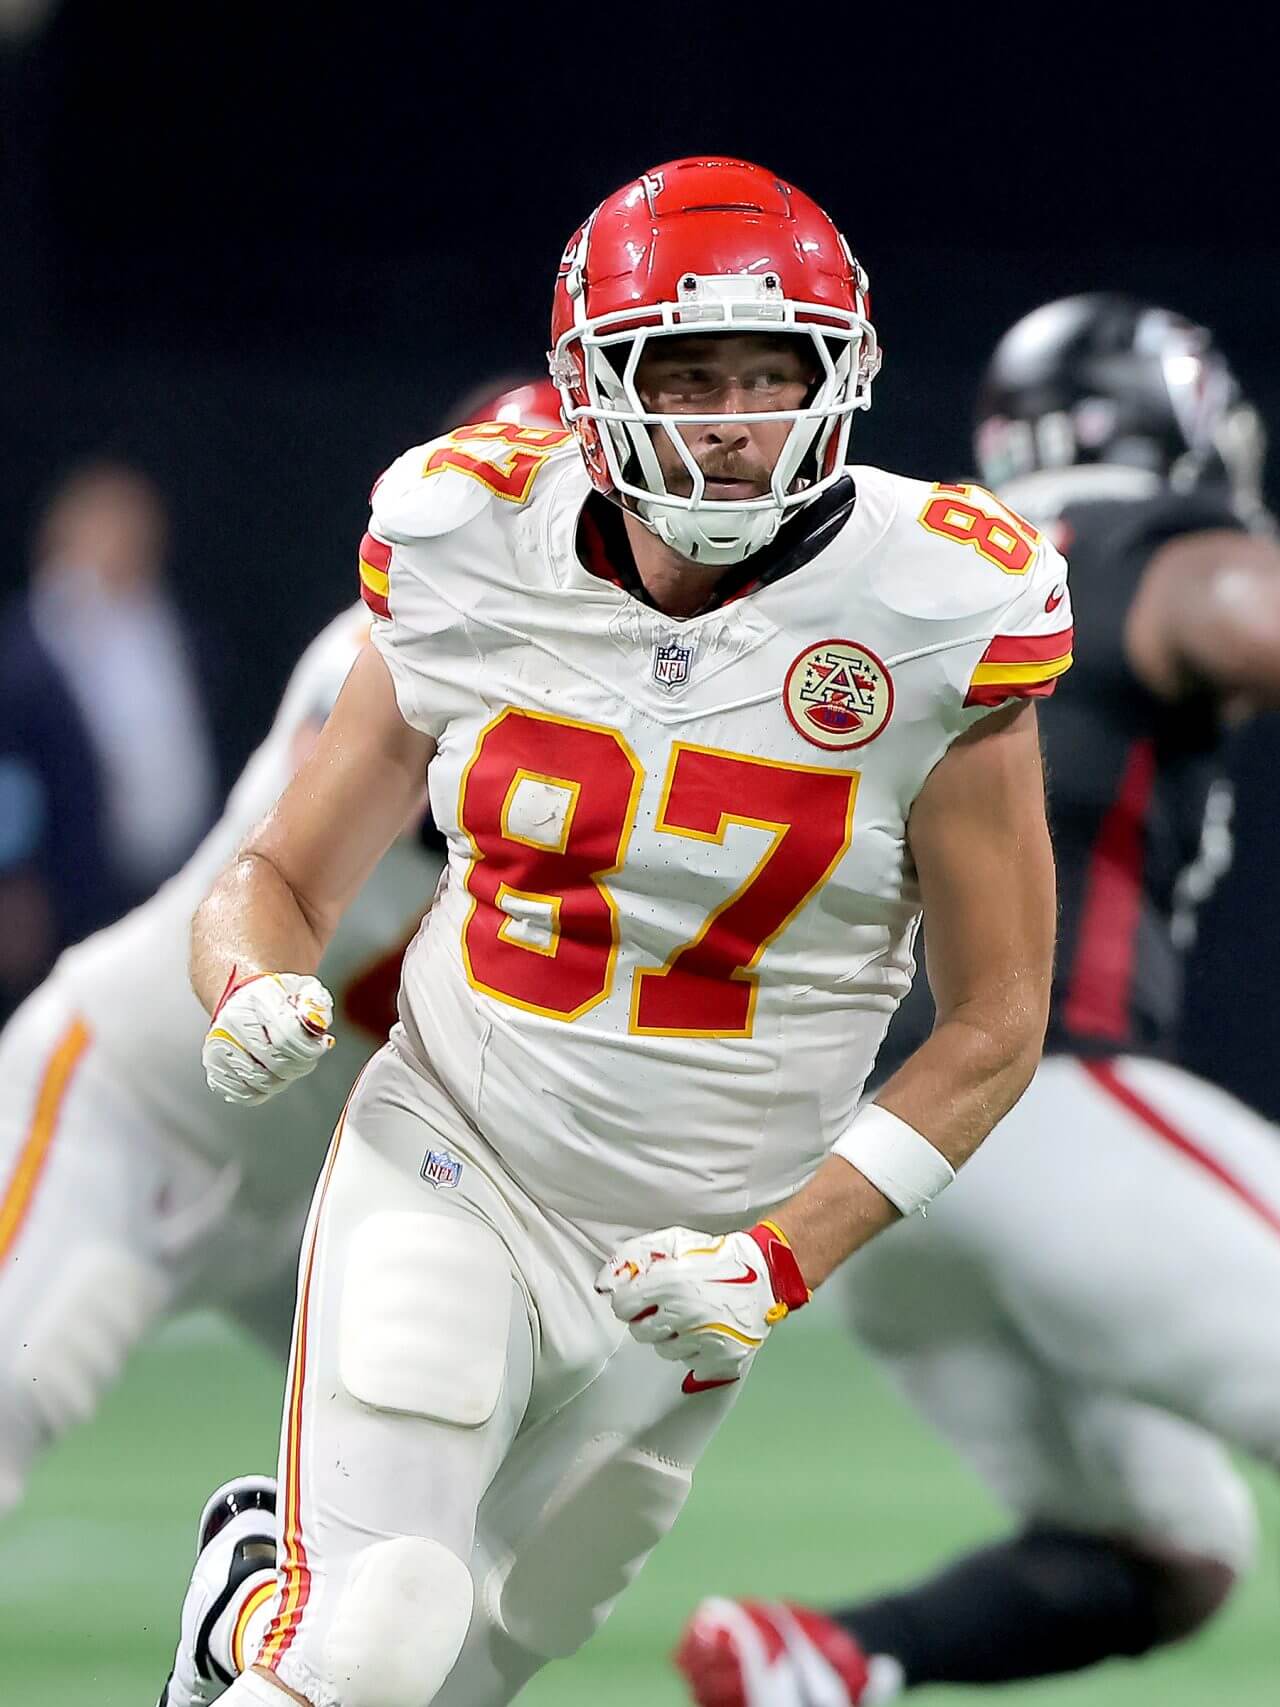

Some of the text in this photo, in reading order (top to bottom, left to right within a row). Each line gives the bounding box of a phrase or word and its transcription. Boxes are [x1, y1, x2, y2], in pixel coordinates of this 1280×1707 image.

[422, 420, 574, 504] 87
[659, 661, 684, 679] NFL
[800, 653, 874, 715] A
[457, 705, 862, 1039] 87
[428, 1162, 453, 1182] NFL
